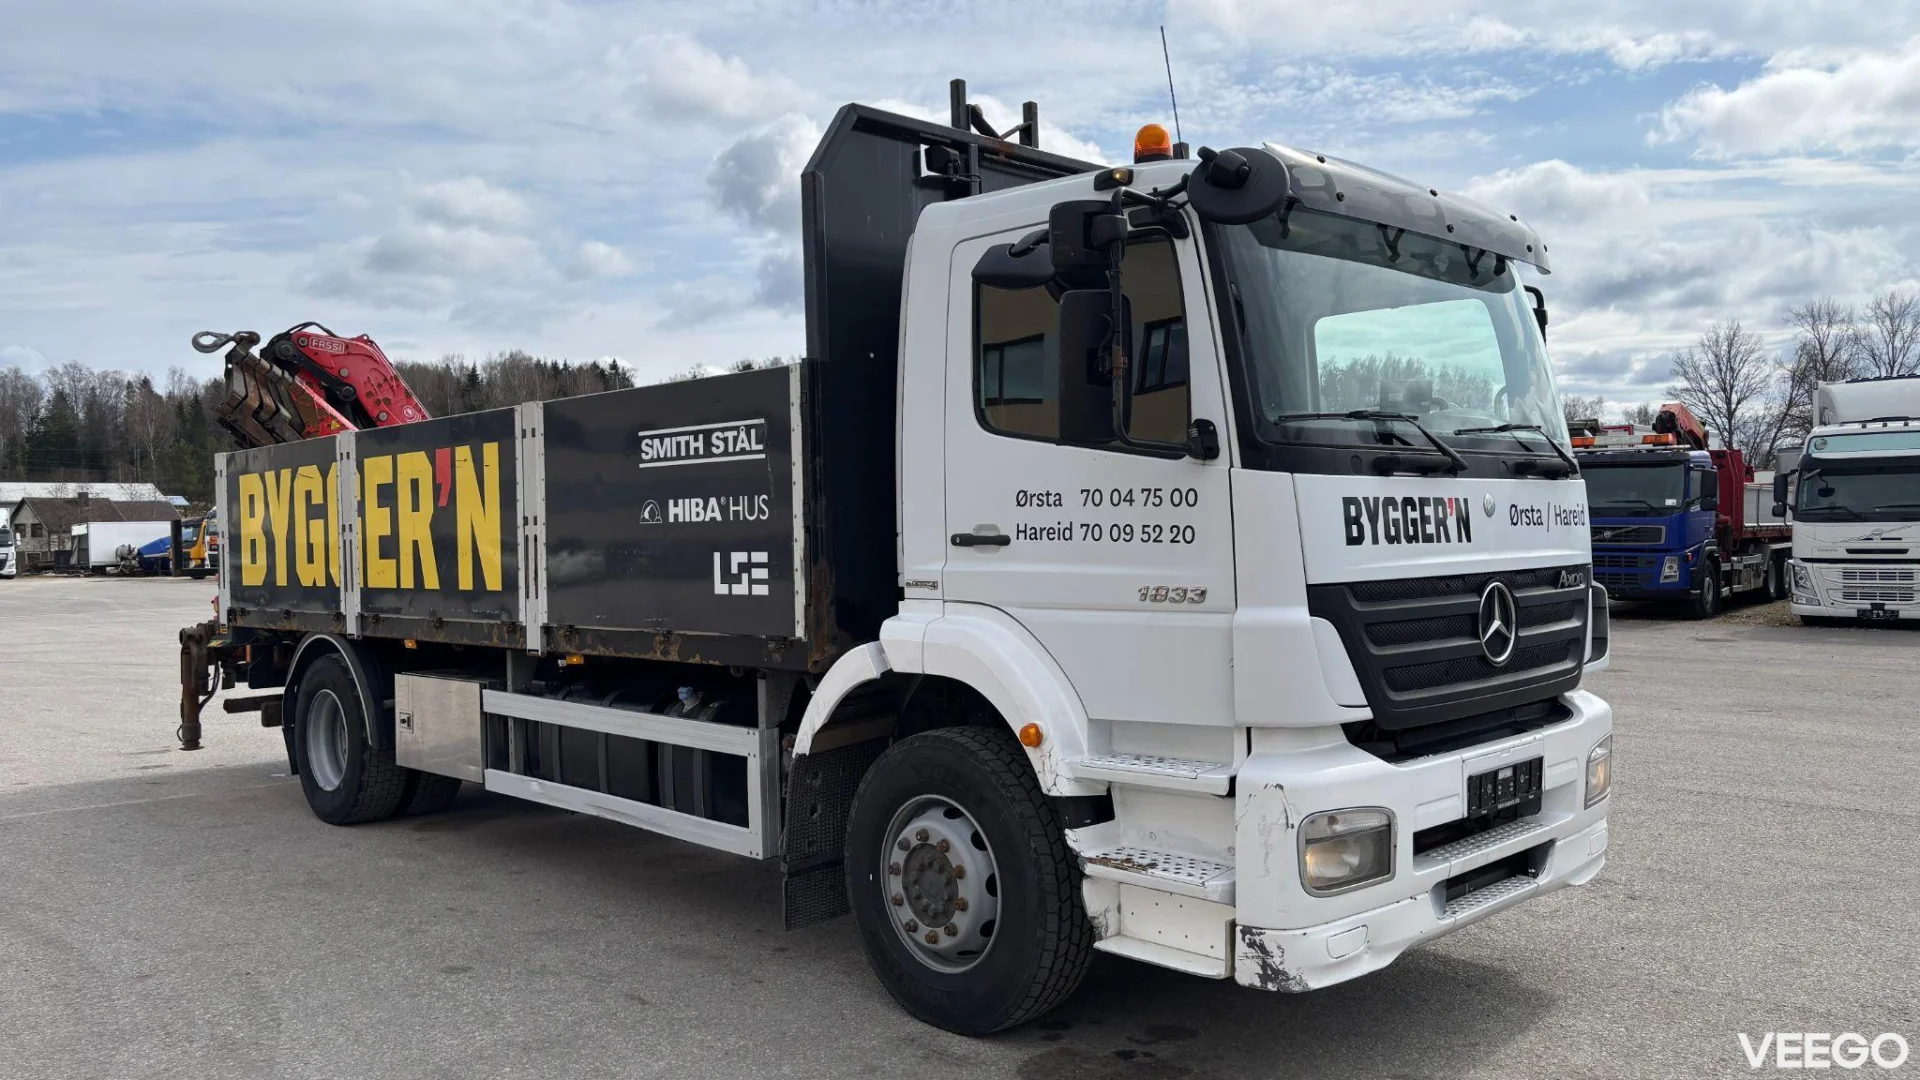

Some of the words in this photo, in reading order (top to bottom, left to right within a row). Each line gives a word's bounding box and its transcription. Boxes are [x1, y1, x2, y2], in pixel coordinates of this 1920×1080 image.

[312, 339, 342, 352] FASSI
[640, 434, 704, 460] SMITH
[711, 426, 764, 455] STÅL
[729, 494, 769, 521] HUS
[1015, 489, 1063, 508] Ørsta
[1080, 488, 1103, 508] 70
[1109, 488, 1136, 508] 04
[1140, 488, 1164, 508] 75
[1169, 487, 1199, 508] 00
[1342, 496, 1472, 546] BYGGER'N
[1509, 503, 1544, 527] Ørsta
[1554, 503, 1586, 527] Hareid
[1015, 521, 1073, 541] Hareid
[1080, 523, 1103, 542] 70
[1109, 523, 1135, 543] 09
[1140, 524, 1164, 544] 52
[1169, 525, 1196, 545] 20
[1138, 585, 1207, 604] 1833
